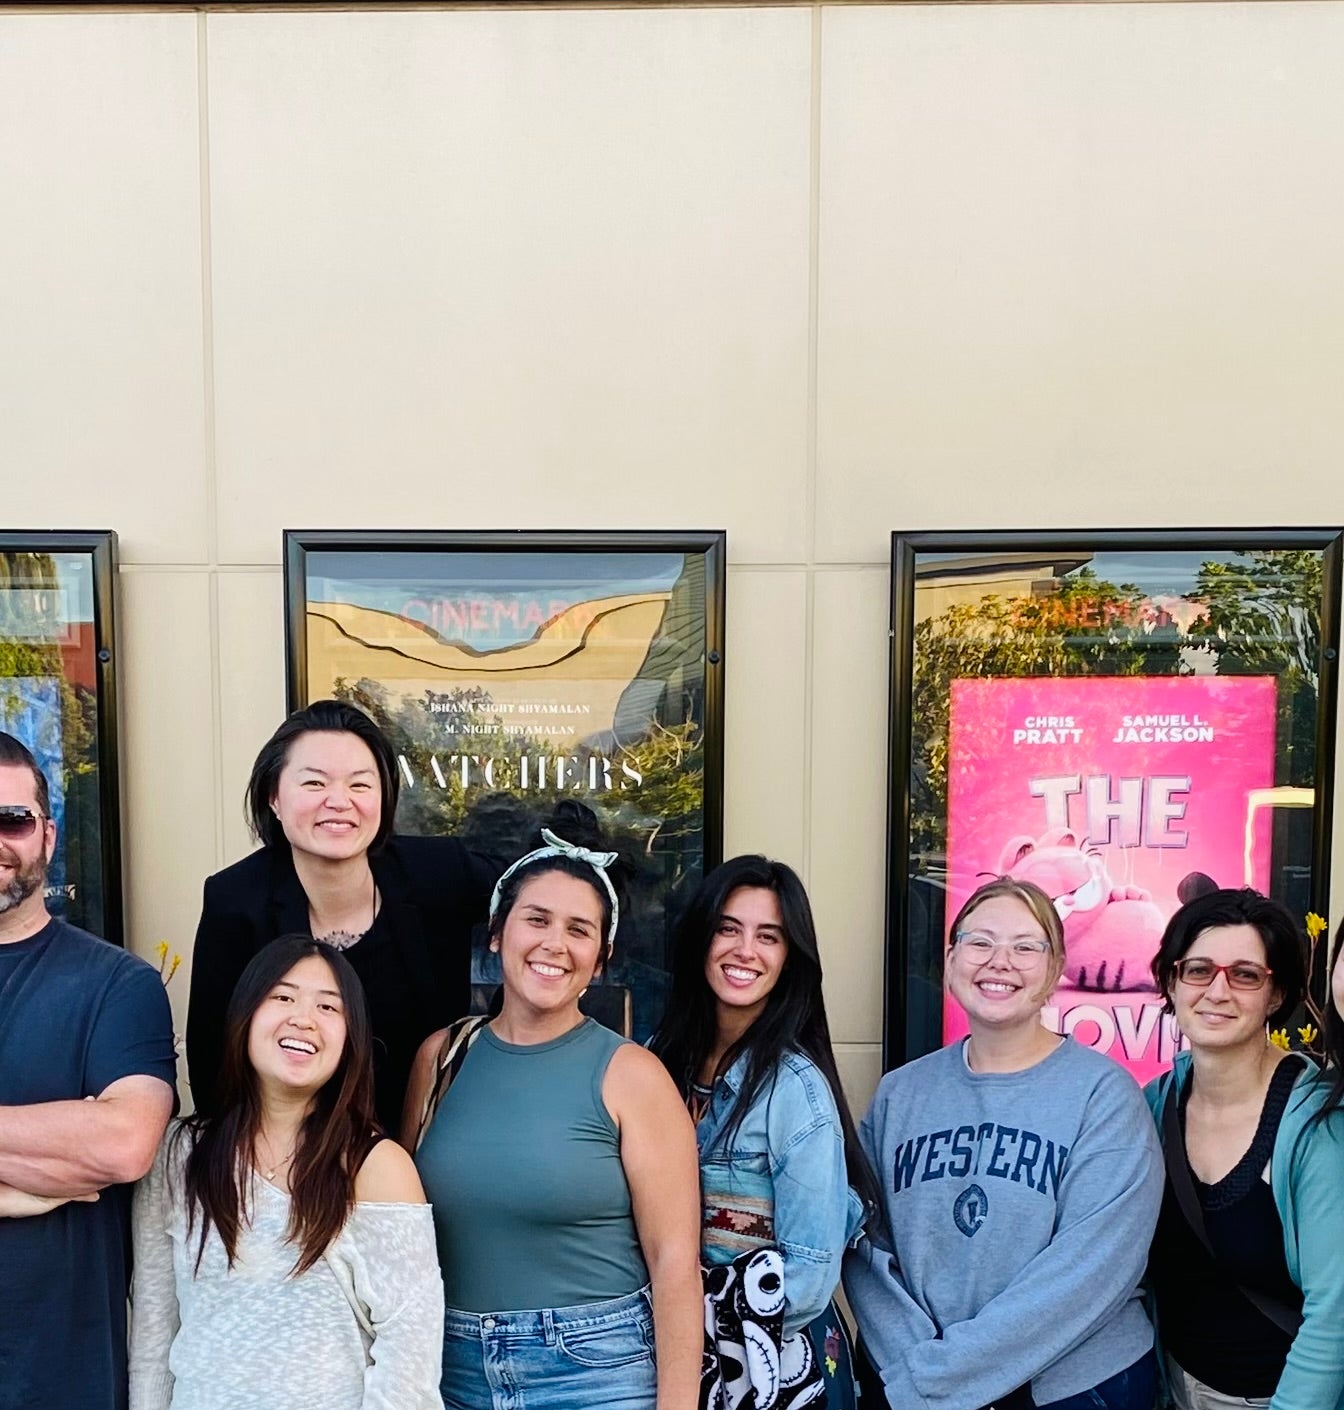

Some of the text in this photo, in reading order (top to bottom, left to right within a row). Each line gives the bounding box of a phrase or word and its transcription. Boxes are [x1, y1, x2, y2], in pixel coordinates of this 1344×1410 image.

[476, 703, 515, 714] NIGHT
[518, 704, 591, 715] SHYAMALAN
[1024, 715, 1075, 729] CHRIS
[1122, 714, 1209, 727] SAMUEL L.
[462, 725, 500, 735] NIGHT
[503, 725, 576, 736] SHYAMALAN
[1013, 728, 1085, 745] PRATT
[1112, 727, 1215, 744] JACKSON
[1028, 772, 1192, 849] THE
[1041, 1003, 1192, 1064] OVI
[893, 1122, 1069, 1201] WESTERN
